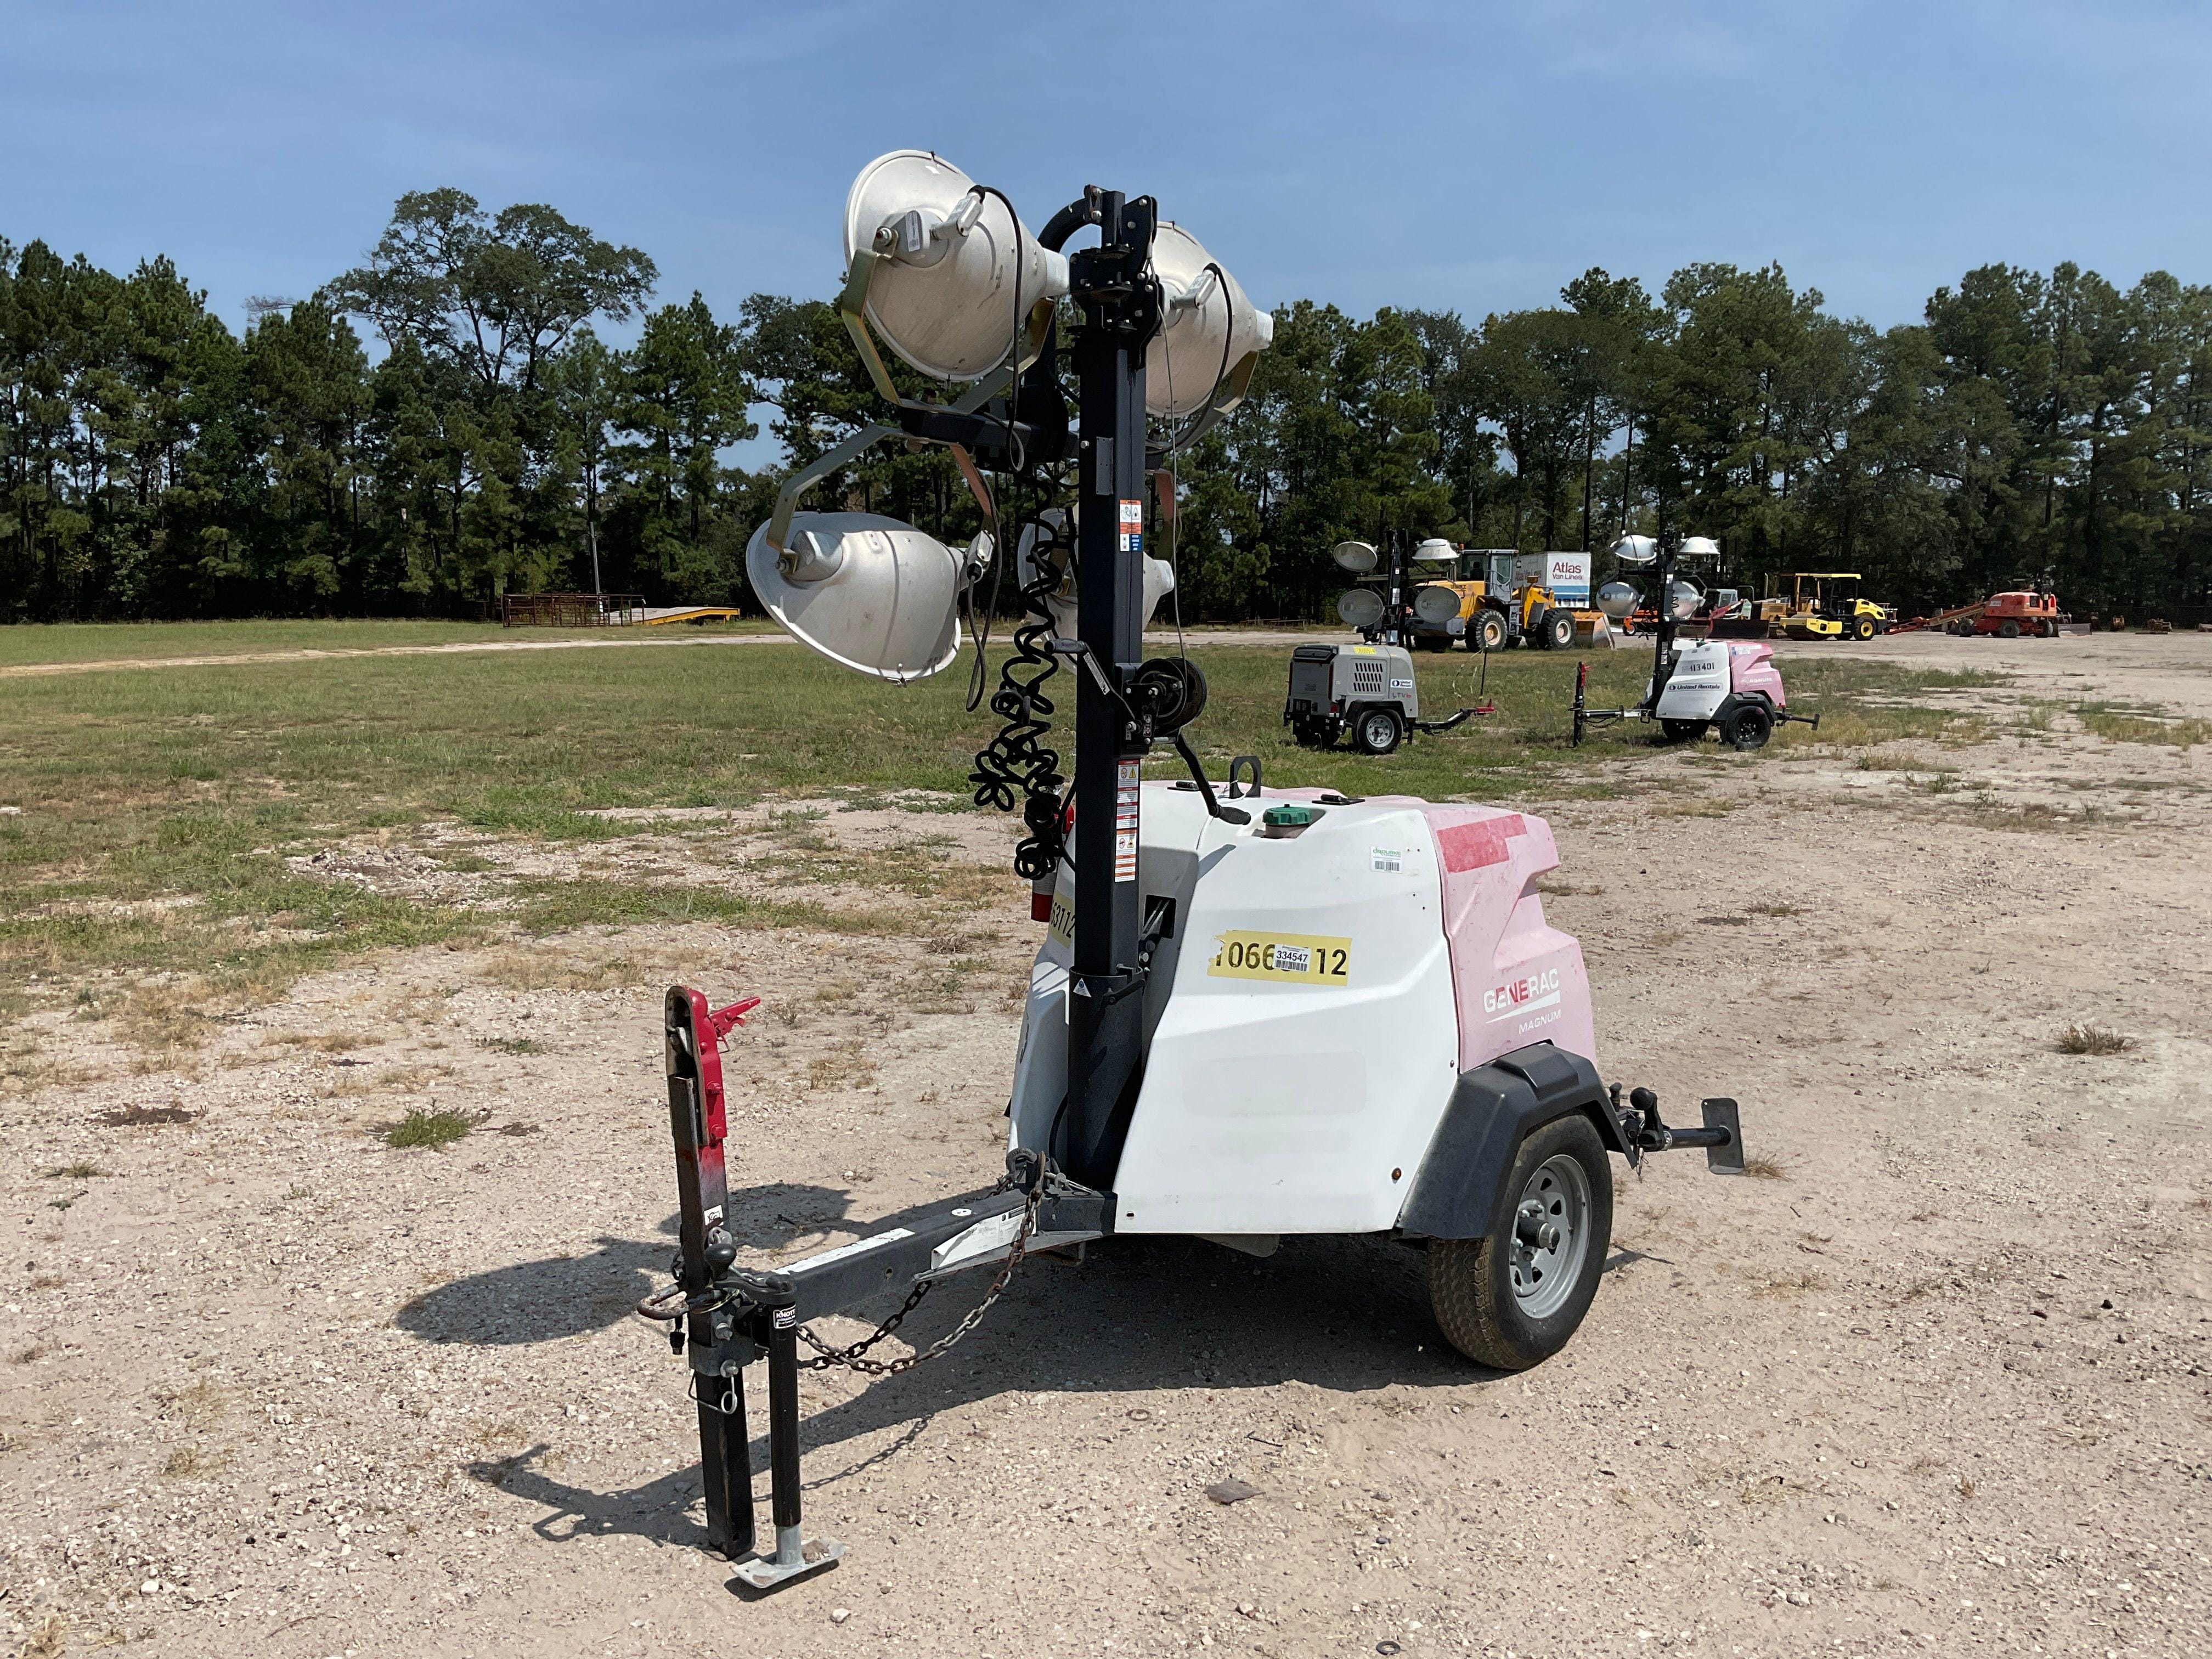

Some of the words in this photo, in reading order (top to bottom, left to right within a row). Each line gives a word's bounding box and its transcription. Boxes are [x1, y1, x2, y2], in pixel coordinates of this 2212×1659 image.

[1553, 562, 1582, 573] Atlas
[1276, 950, 1308, 962] 334547
[1483, 968, 1559, 1013] GENERAC
[1519, 1009, 1561, 1034] MAGNUM
[776, 1308, 795, 1318] KNOTT
